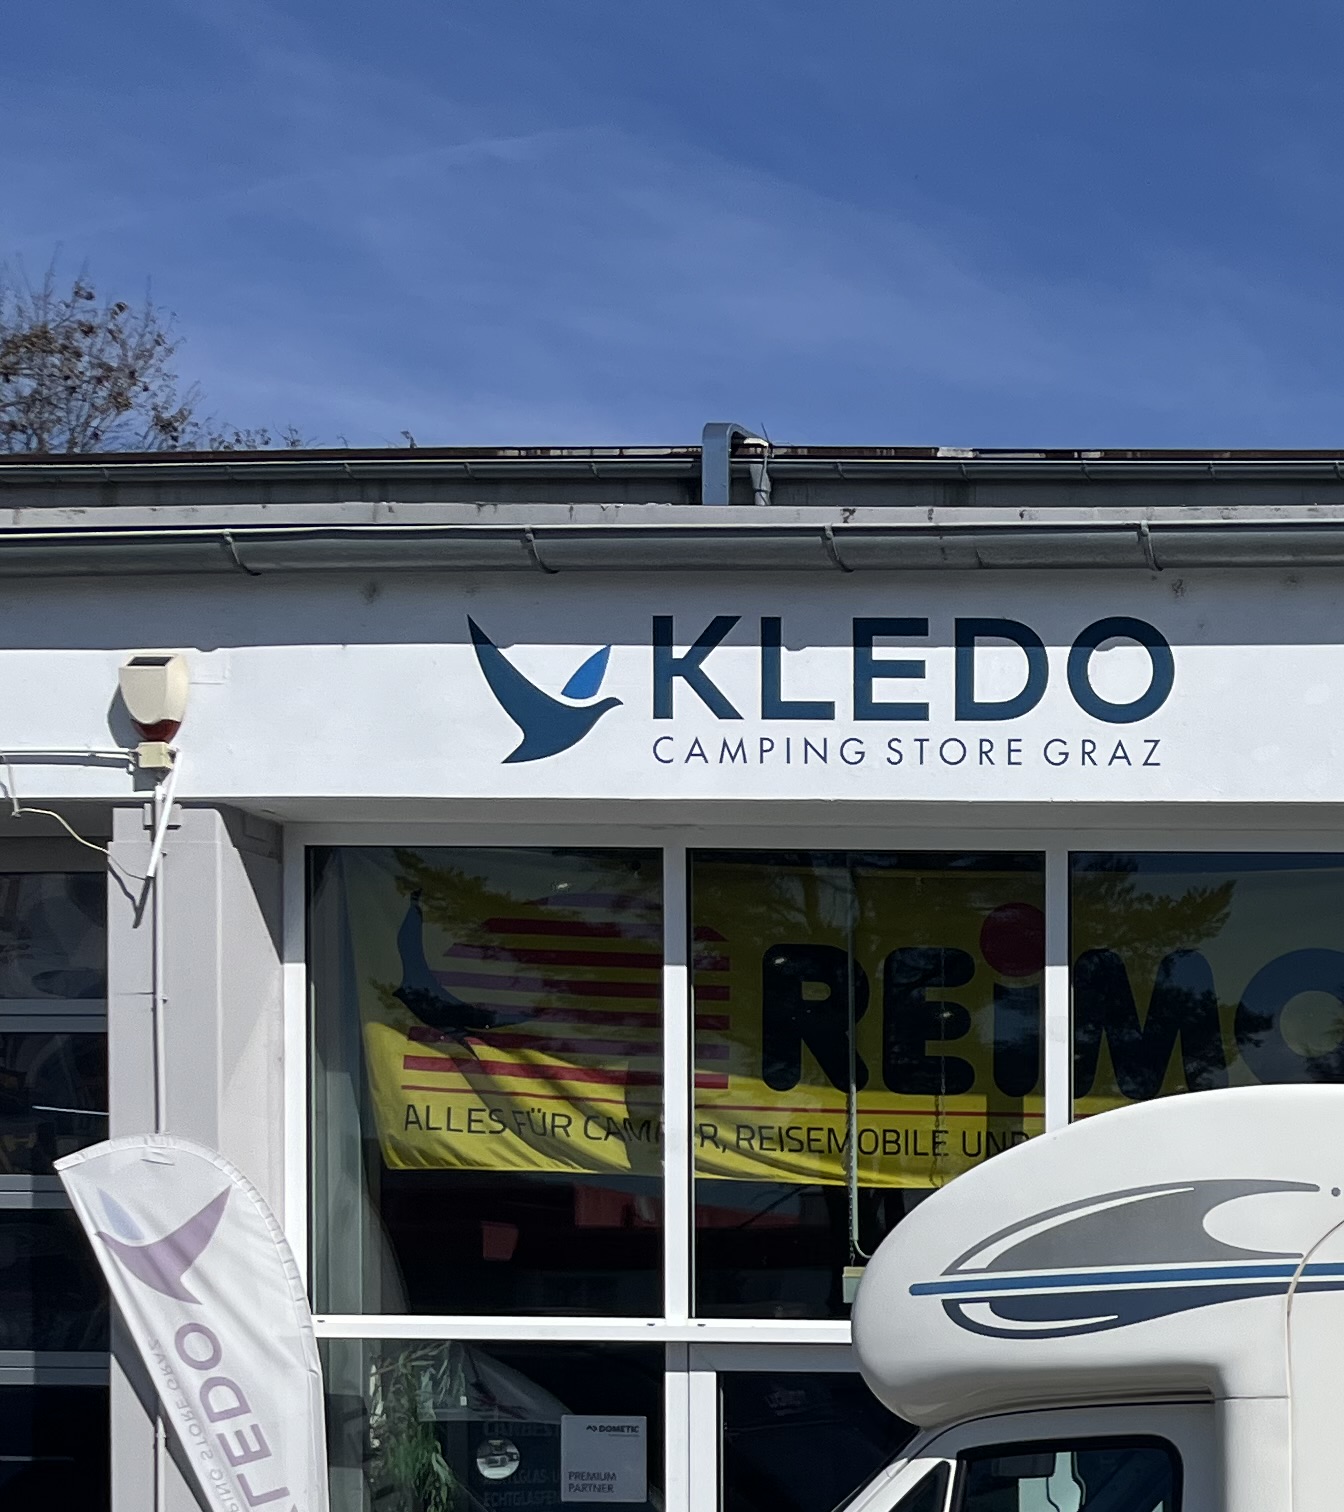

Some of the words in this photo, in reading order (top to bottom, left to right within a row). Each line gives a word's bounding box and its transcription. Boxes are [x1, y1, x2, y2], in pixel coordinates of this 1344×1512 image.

[652, 614, 1176, 725] KLEDO
[652, 736, 866, 766] CAMPING
[886, 737, 1023, 767] STORE
[1043, 738, 1162, 767] GRAZ
[403, 1103, 507, 1137] ALLES
[511, 1107, 573, 1139] FÜR
[735, 1123, 949, 1157] REISEMOBILE
[598, 1425, 640, 1434] DOMETIC
[567, 1471, 617, 1482] PREMIUM
[567, 1483, 615, 1494] PARTNER
